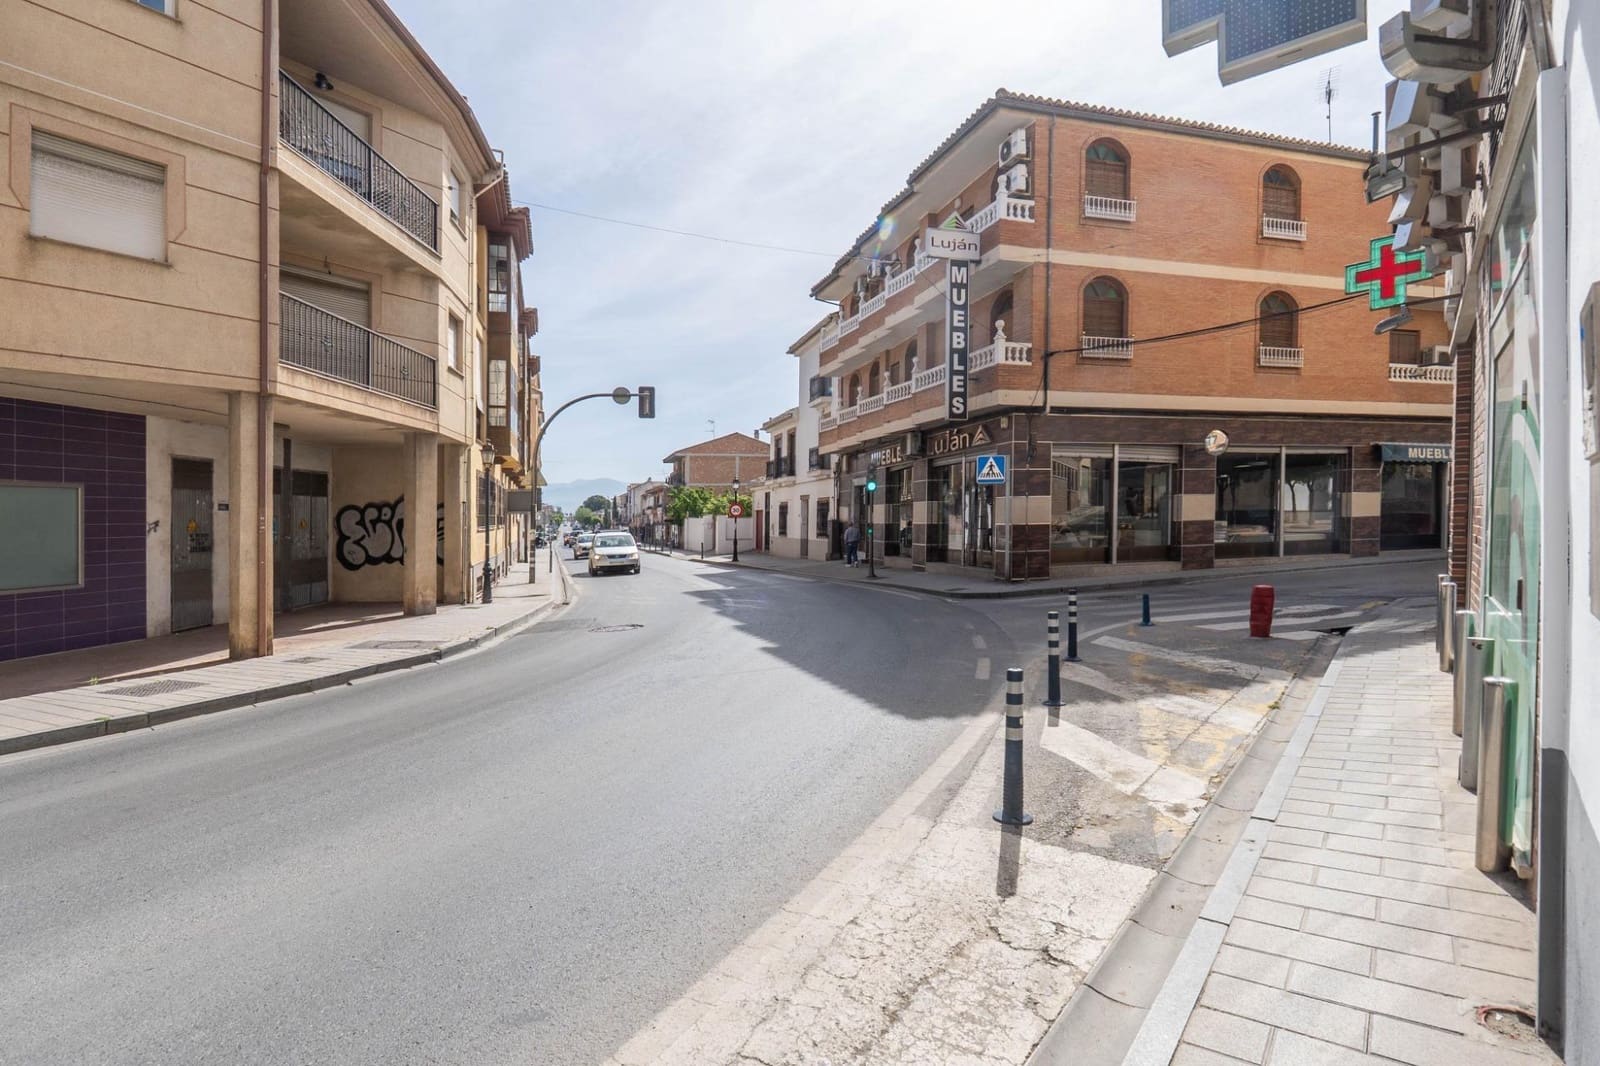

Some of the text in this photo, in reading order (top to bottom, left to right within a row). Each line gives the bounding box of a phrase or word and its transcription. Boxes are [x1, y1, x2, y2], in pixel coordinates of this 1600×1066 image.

[931, 236, 978, 252] Luján
[951, 266, 967, 414] MUEBLES
[930, 428, 969, 455] uján
[871, 446, 905, 465] MUEBLE
[1408, 447, 1452, 459] MUEBL
